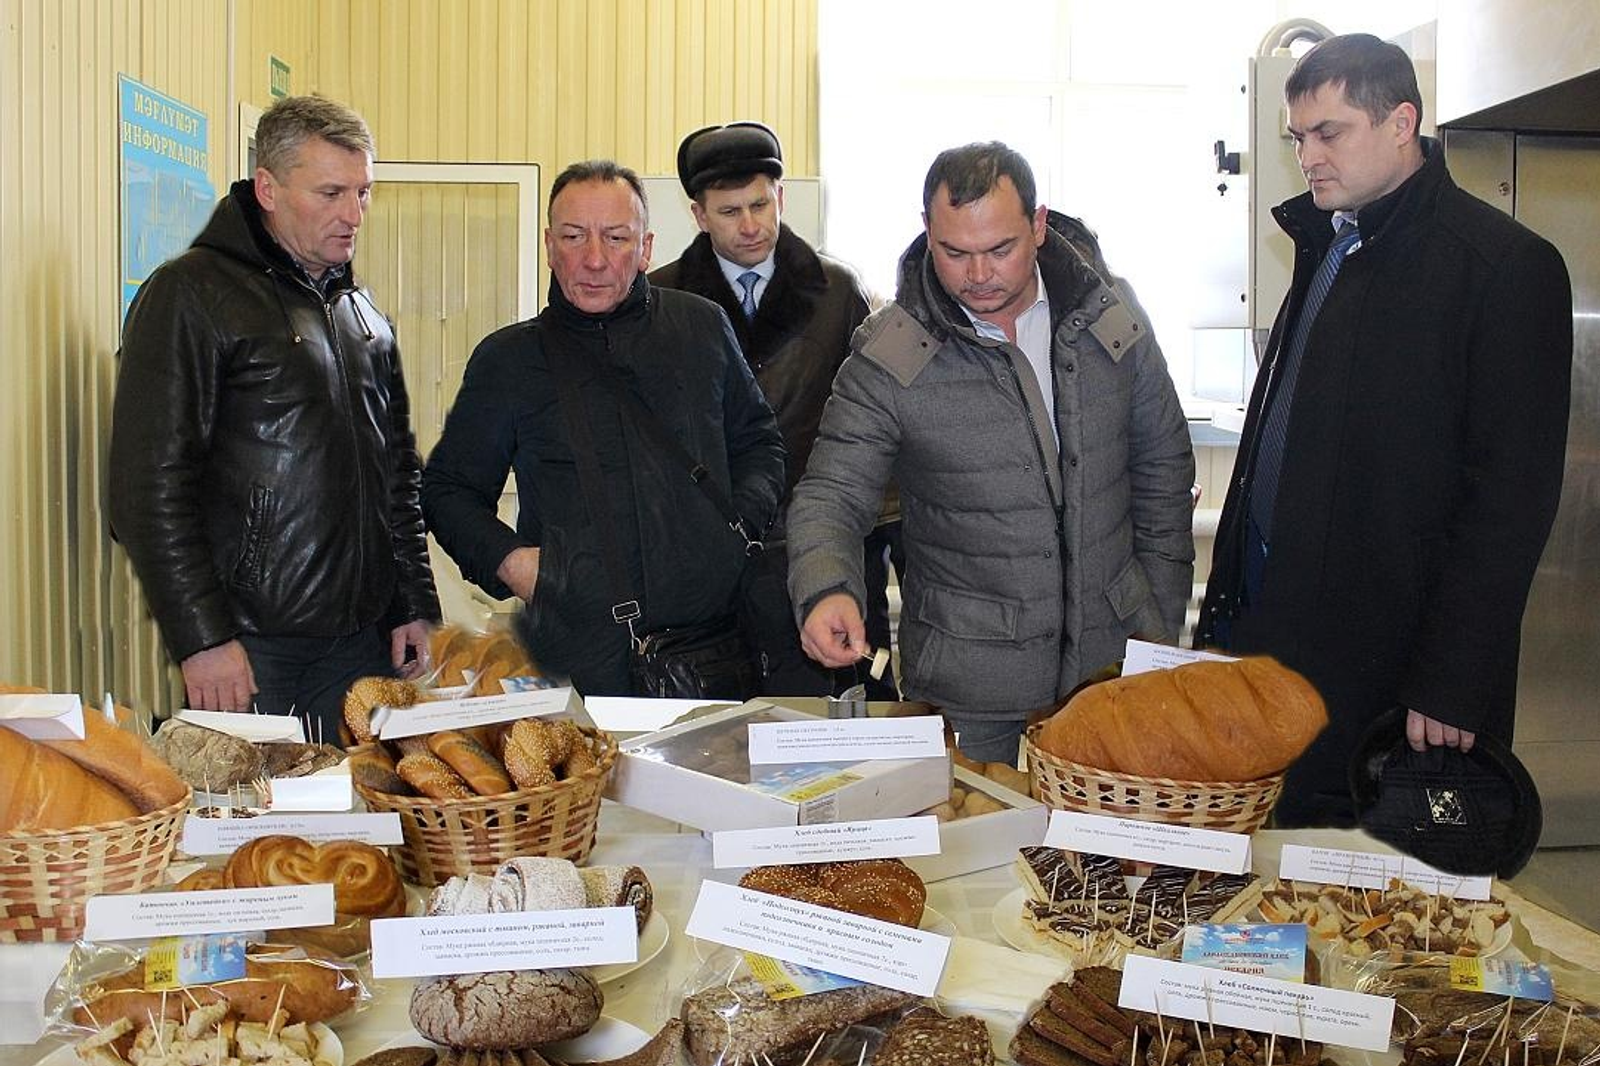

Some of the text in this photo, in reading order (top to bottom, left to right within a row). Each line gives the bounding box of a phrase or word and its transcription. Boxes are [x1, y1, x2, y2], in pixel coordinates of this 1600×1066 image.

[123, 121, 207, 171] ИНФОРМАЦИЯ
[420, 928, 440, 937] Хлеб
[884, 930, 923, 945] семенами
[1218, 978, 1238, 988] Хлеб
